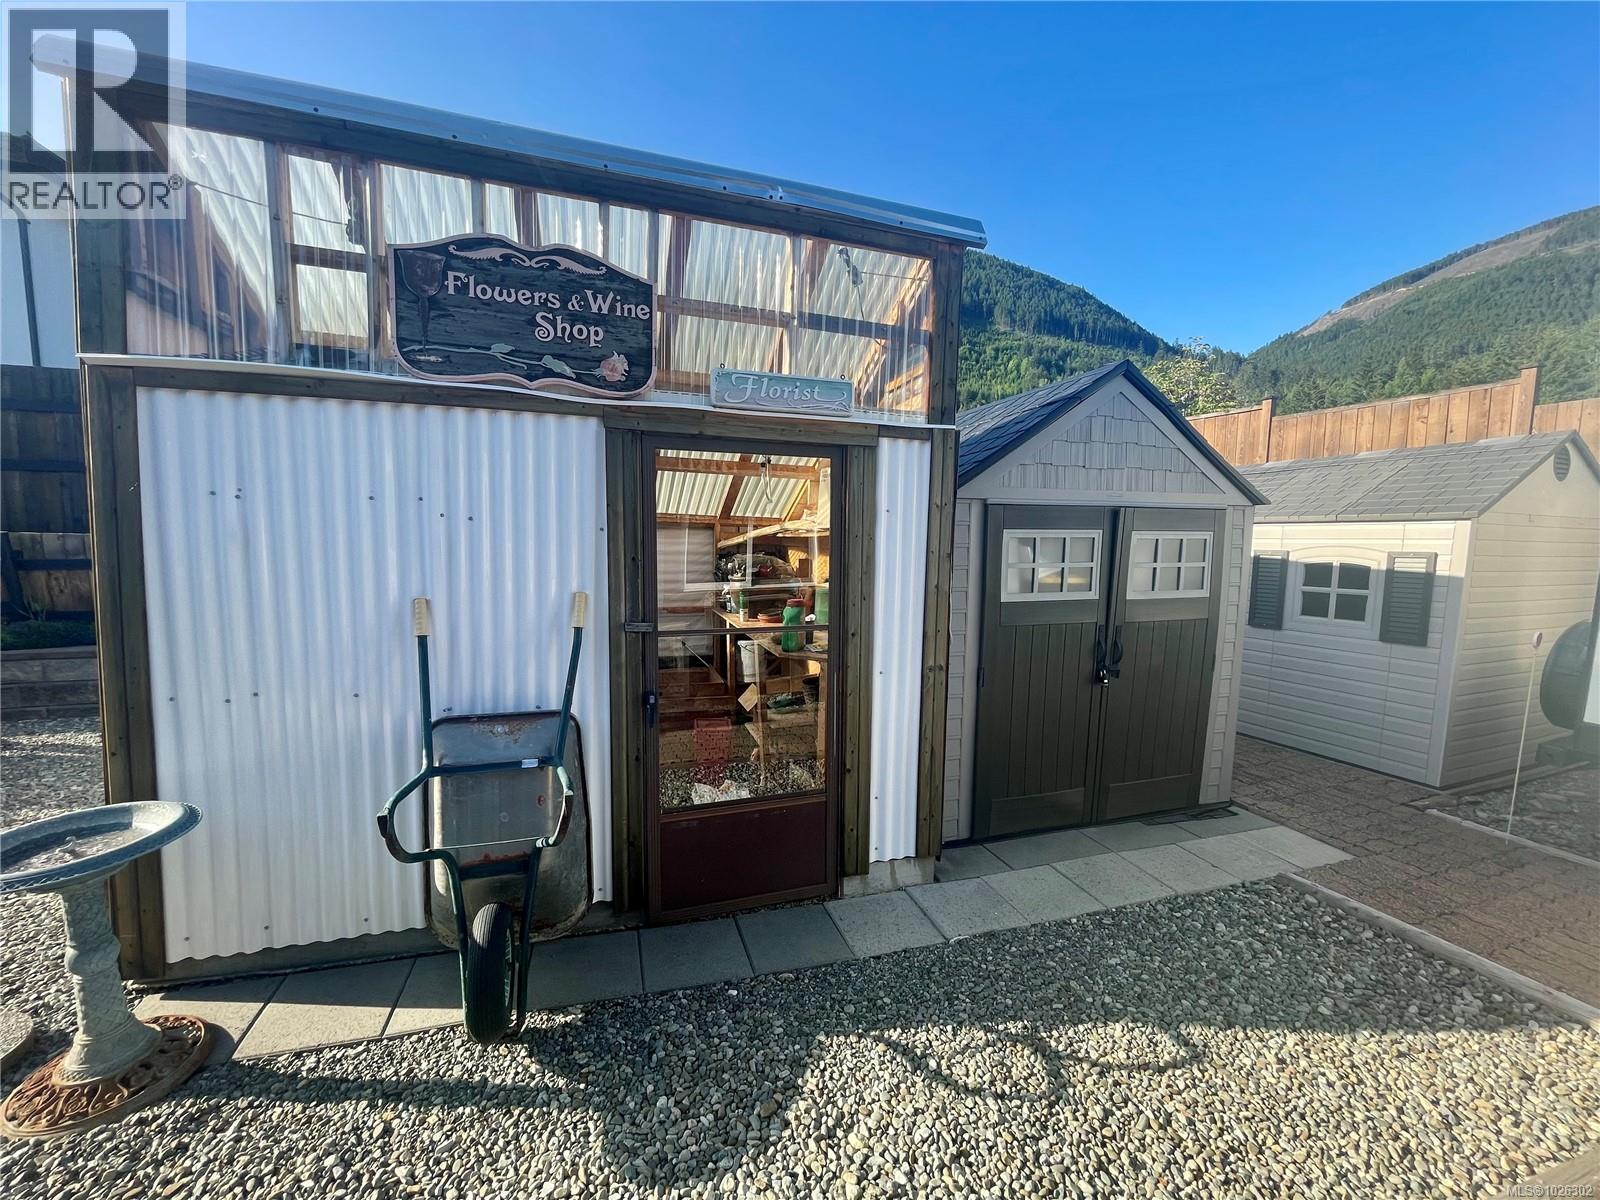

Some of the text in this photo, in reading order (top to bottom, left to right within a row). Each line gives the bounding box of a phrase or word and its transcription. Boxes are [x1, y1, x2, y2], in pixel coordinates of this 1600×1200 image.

[444, 270, 650, 320] Flowers & Wine
[534, 311, 604, 348] Shop
[723, 373, 847, 403] Florist
